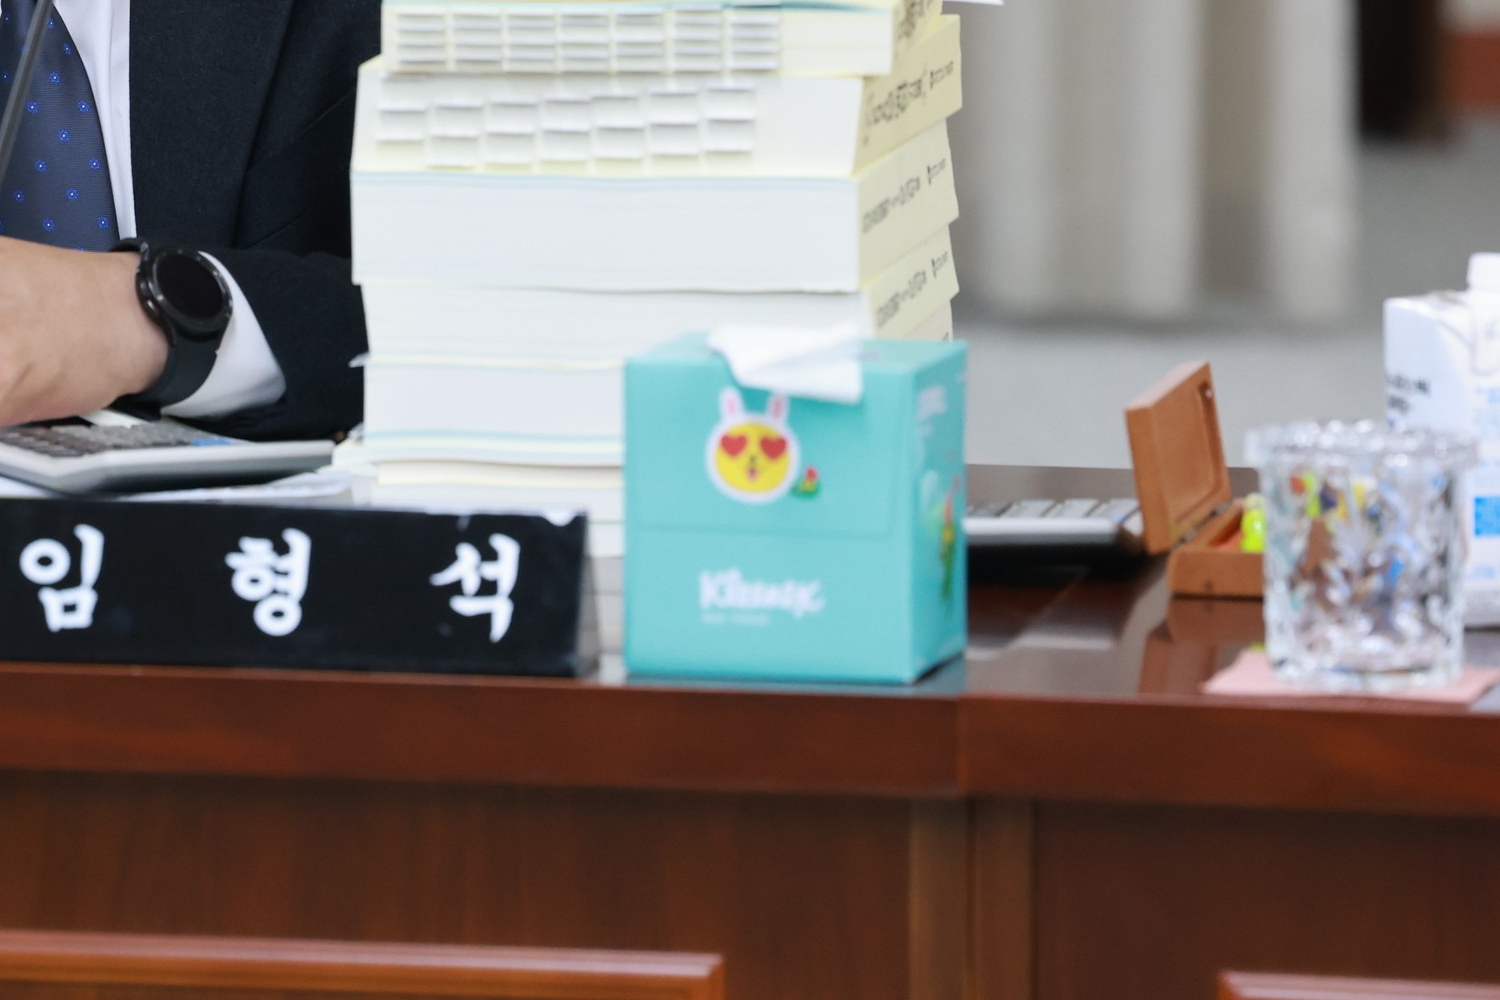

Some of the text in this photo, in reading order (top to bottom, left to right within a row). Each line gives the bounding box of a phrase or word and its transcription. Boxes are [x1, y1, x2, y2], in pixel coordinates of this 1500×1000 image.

[20, 525, 521, 642] 임 형 석
